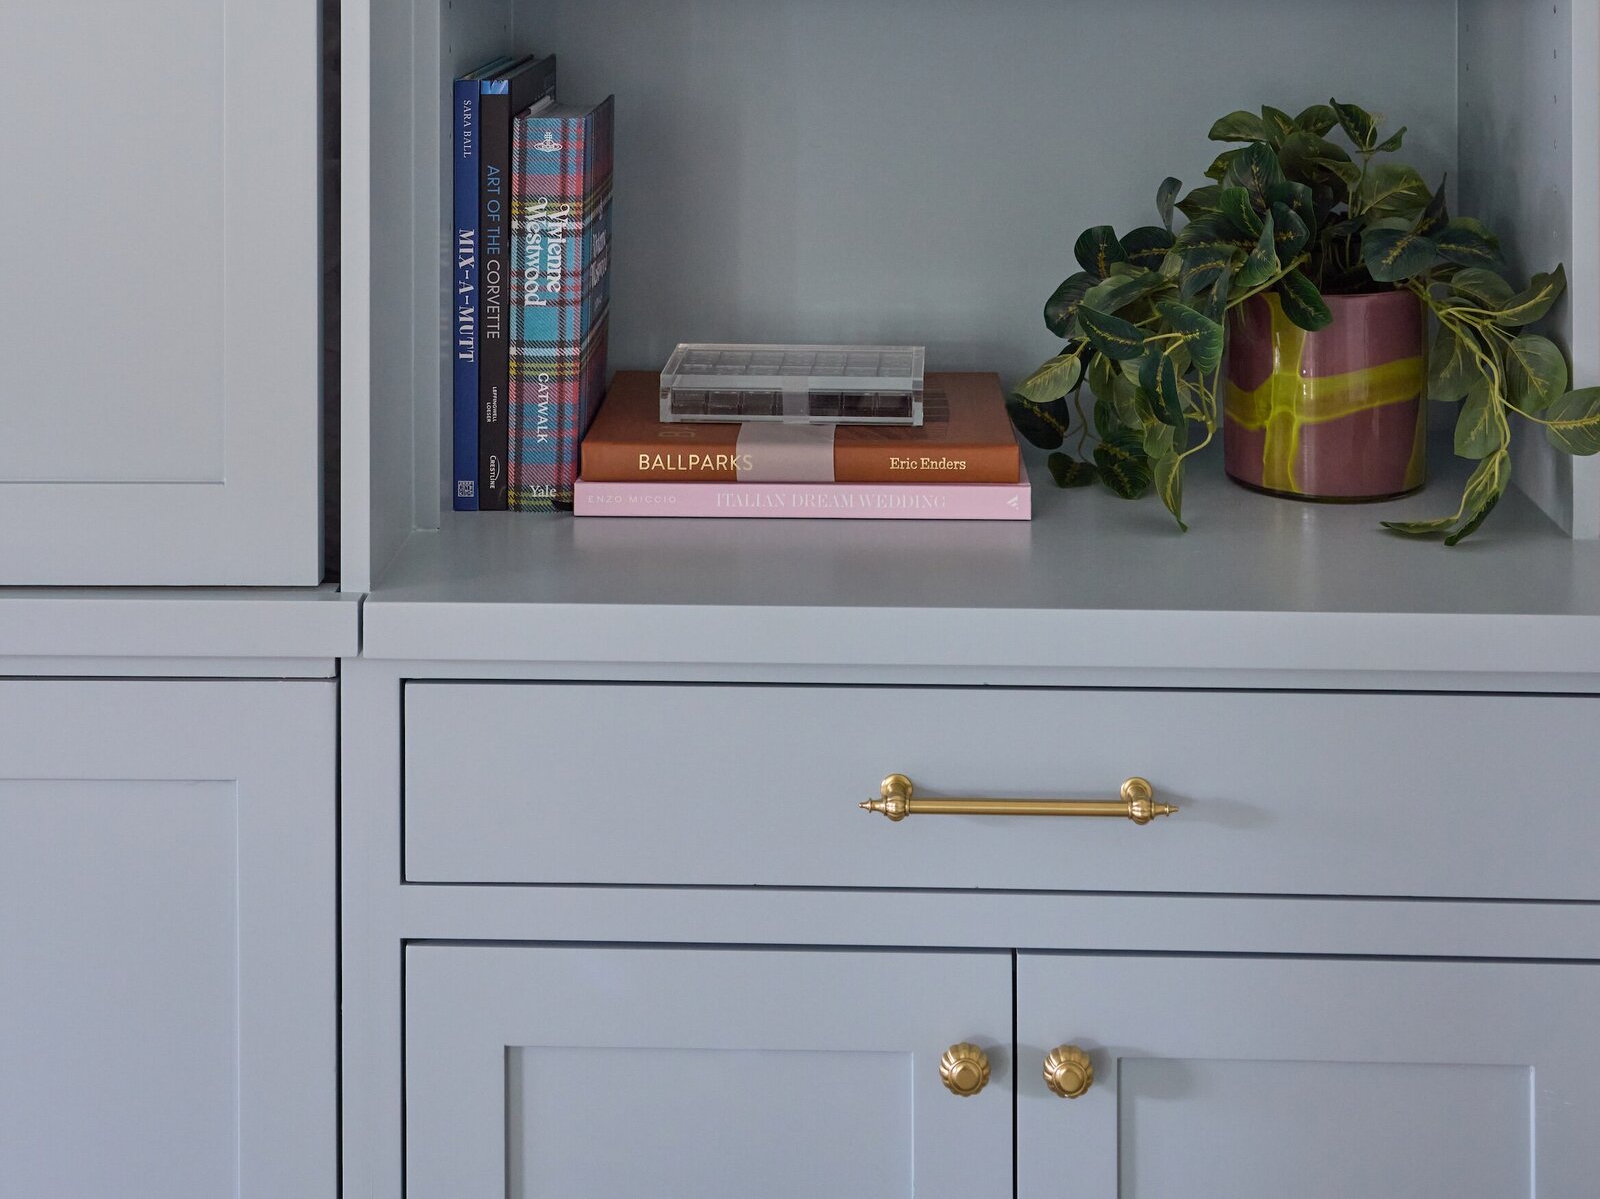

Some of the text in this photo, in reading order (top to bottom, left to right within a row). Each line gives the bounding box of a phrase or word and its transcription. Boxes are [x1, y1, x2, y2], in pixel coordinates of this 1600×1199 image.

[463, 99, 472, 158] SARA BALL
[486, 165, 500, 339] ART OF THE CORVETTE
[524, 196, 548, 306] Westwood
[546, 203, 570, 293] Vivienne
[458, 228, 475, 363] MIX-A-MUTT
[536, 372, 550, 443] CATWALK
[489, 455, 498, 489] CRESTLINE
[638, 453, 753, 470] BALLPARKS
[889, 457, 966, 470] Eric Enders
[530, 485, 557, 498] Yale
[587, 495, 677, 503] ENZO MICCIO
[716, 493, 946, 508] ITALIAN DREAM WEDDING
